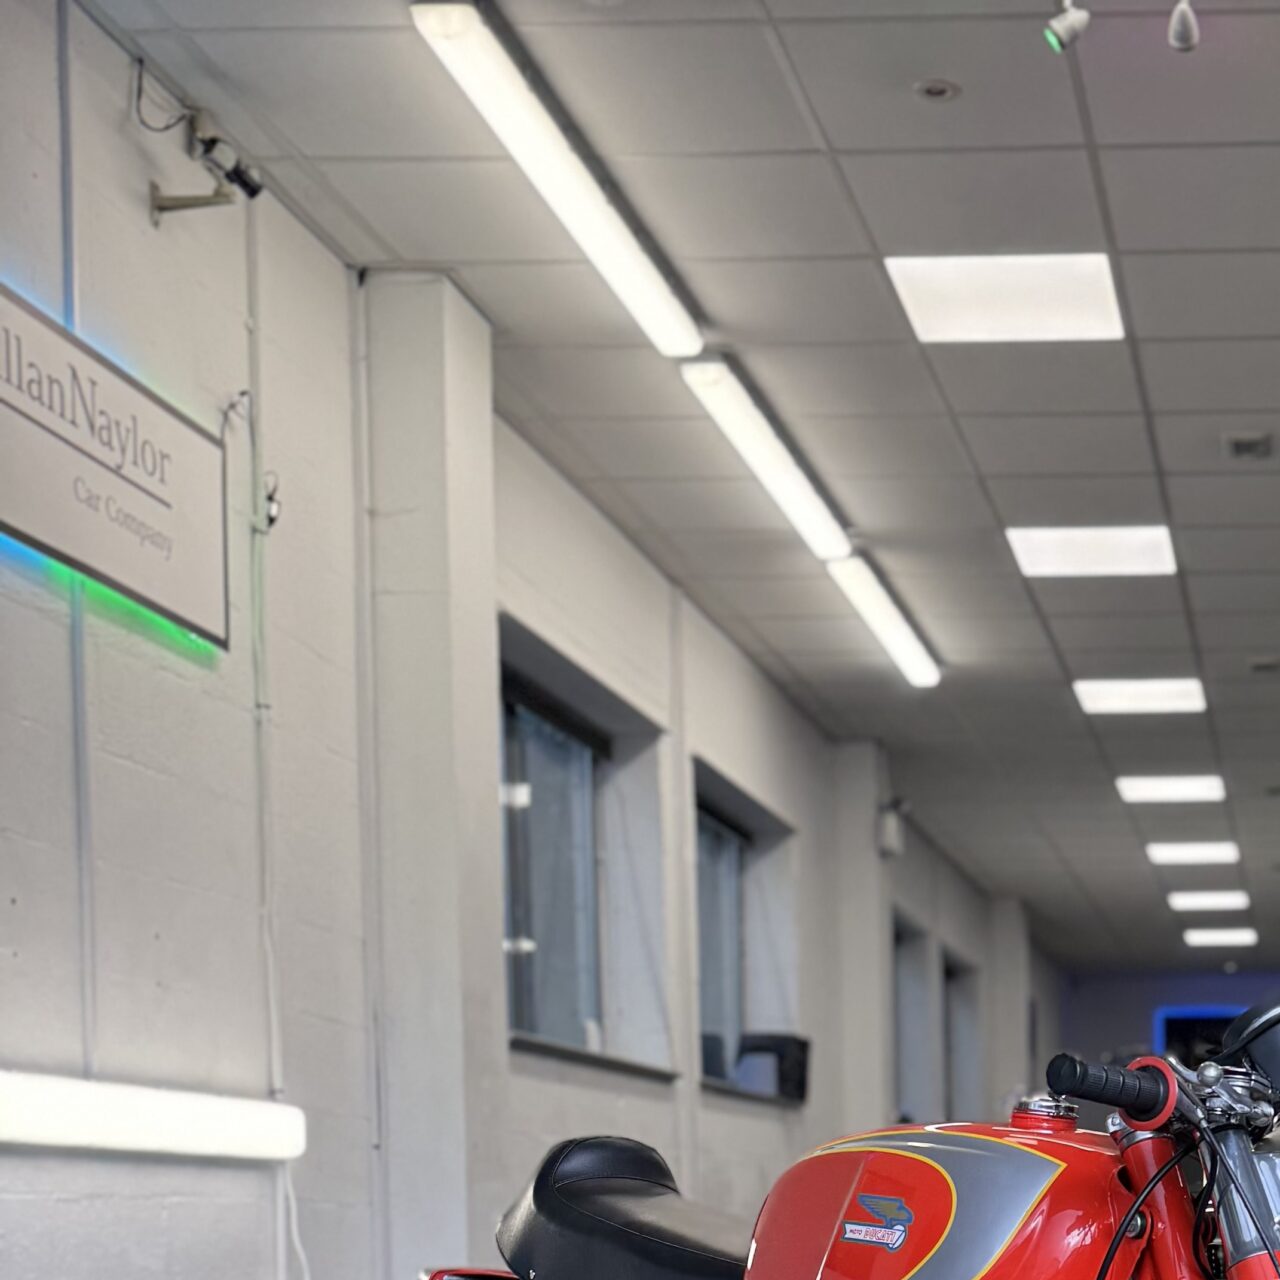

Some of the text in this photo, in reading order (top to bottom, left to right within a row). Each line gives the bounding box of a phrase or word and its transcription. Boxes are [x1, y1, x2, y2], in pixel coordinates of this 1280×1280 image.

[0, 326, 173, 486] llanNaylor
[73, 476, 174, 562] Car Company
[863, 1228, 896, 1243] DUCATI
